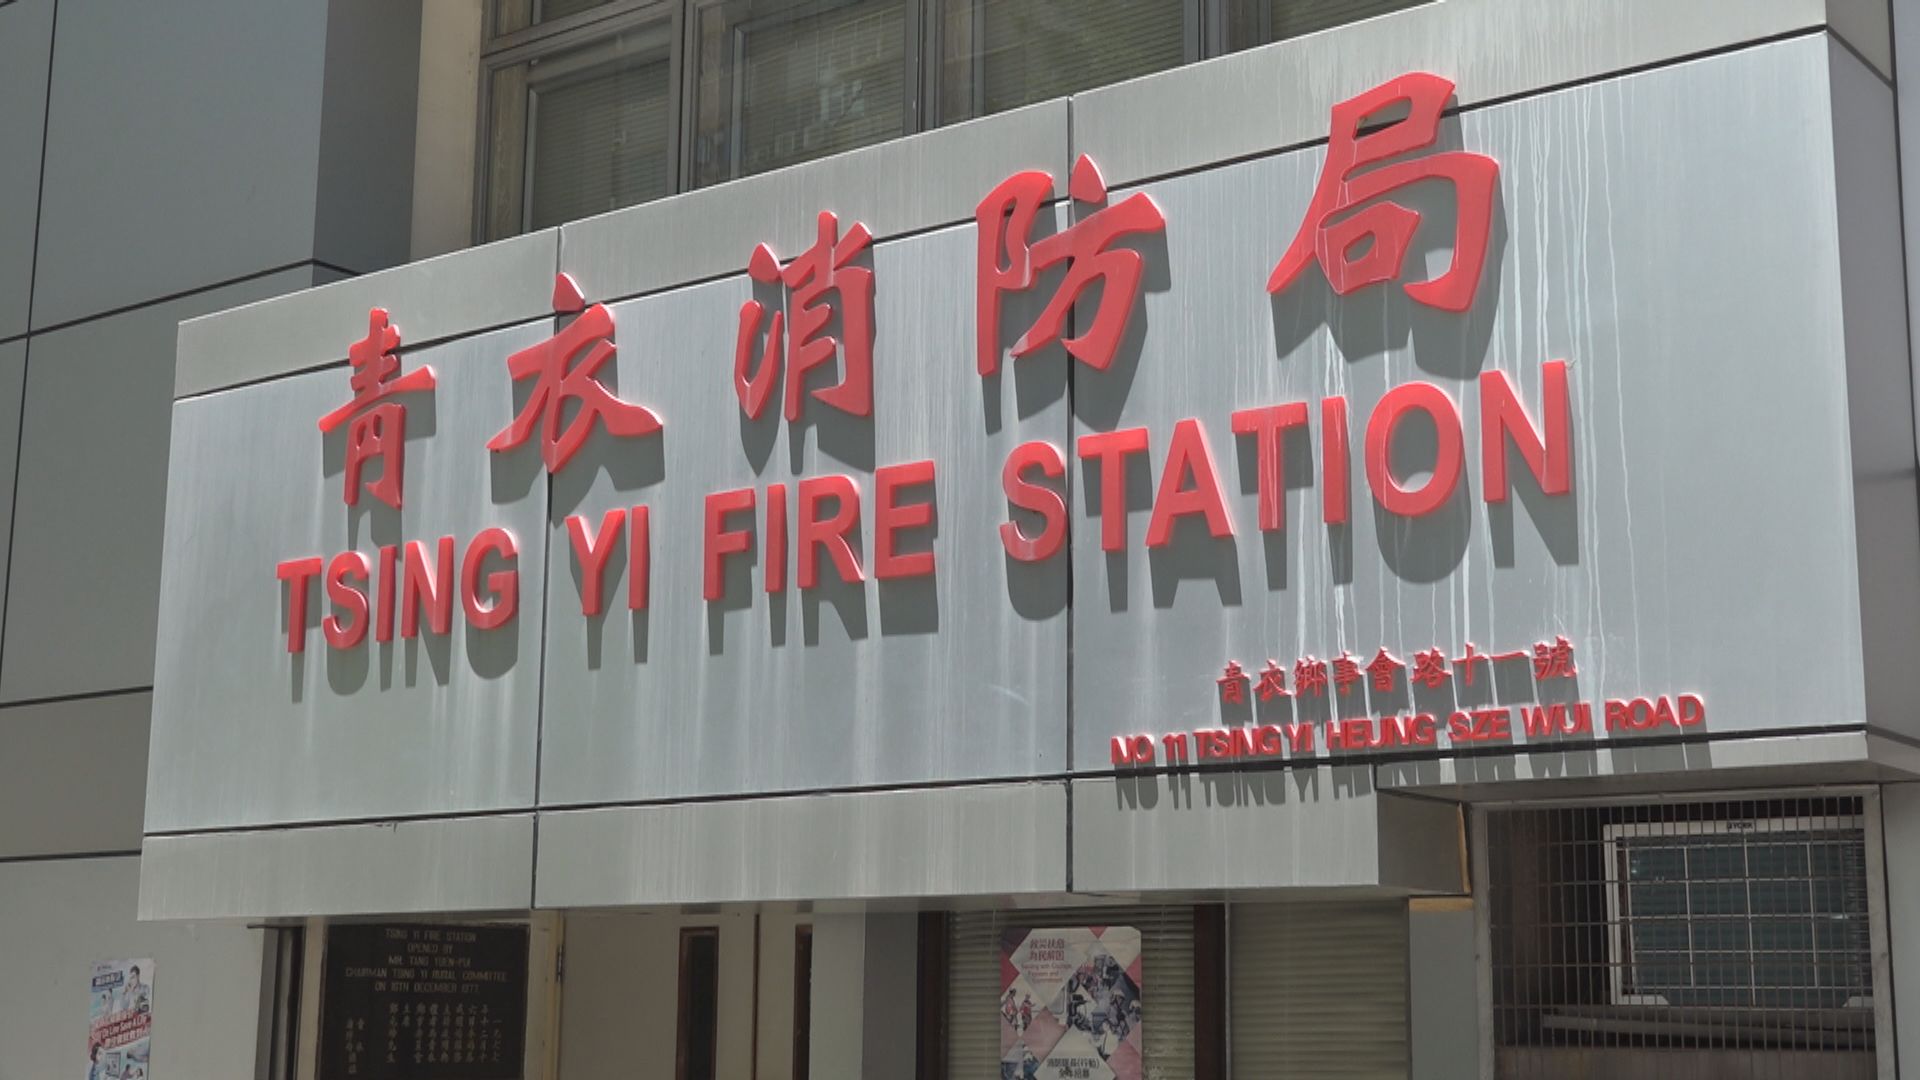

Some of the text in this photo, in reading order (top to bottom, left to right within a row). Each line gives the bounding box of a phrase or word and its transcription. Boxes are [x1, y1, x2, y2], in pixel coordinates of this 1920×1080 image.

[318, 72, 1498, 512] 青衣消防局
[277, 360, 1570, 658] TSING YI FIRE STATION
[1111, 692, 1705, 764] NO 11 TSING YI HEUNG SZE WUI ROAD
[1217, 634, 1577, 704] 青衣鄉事會路十一號
